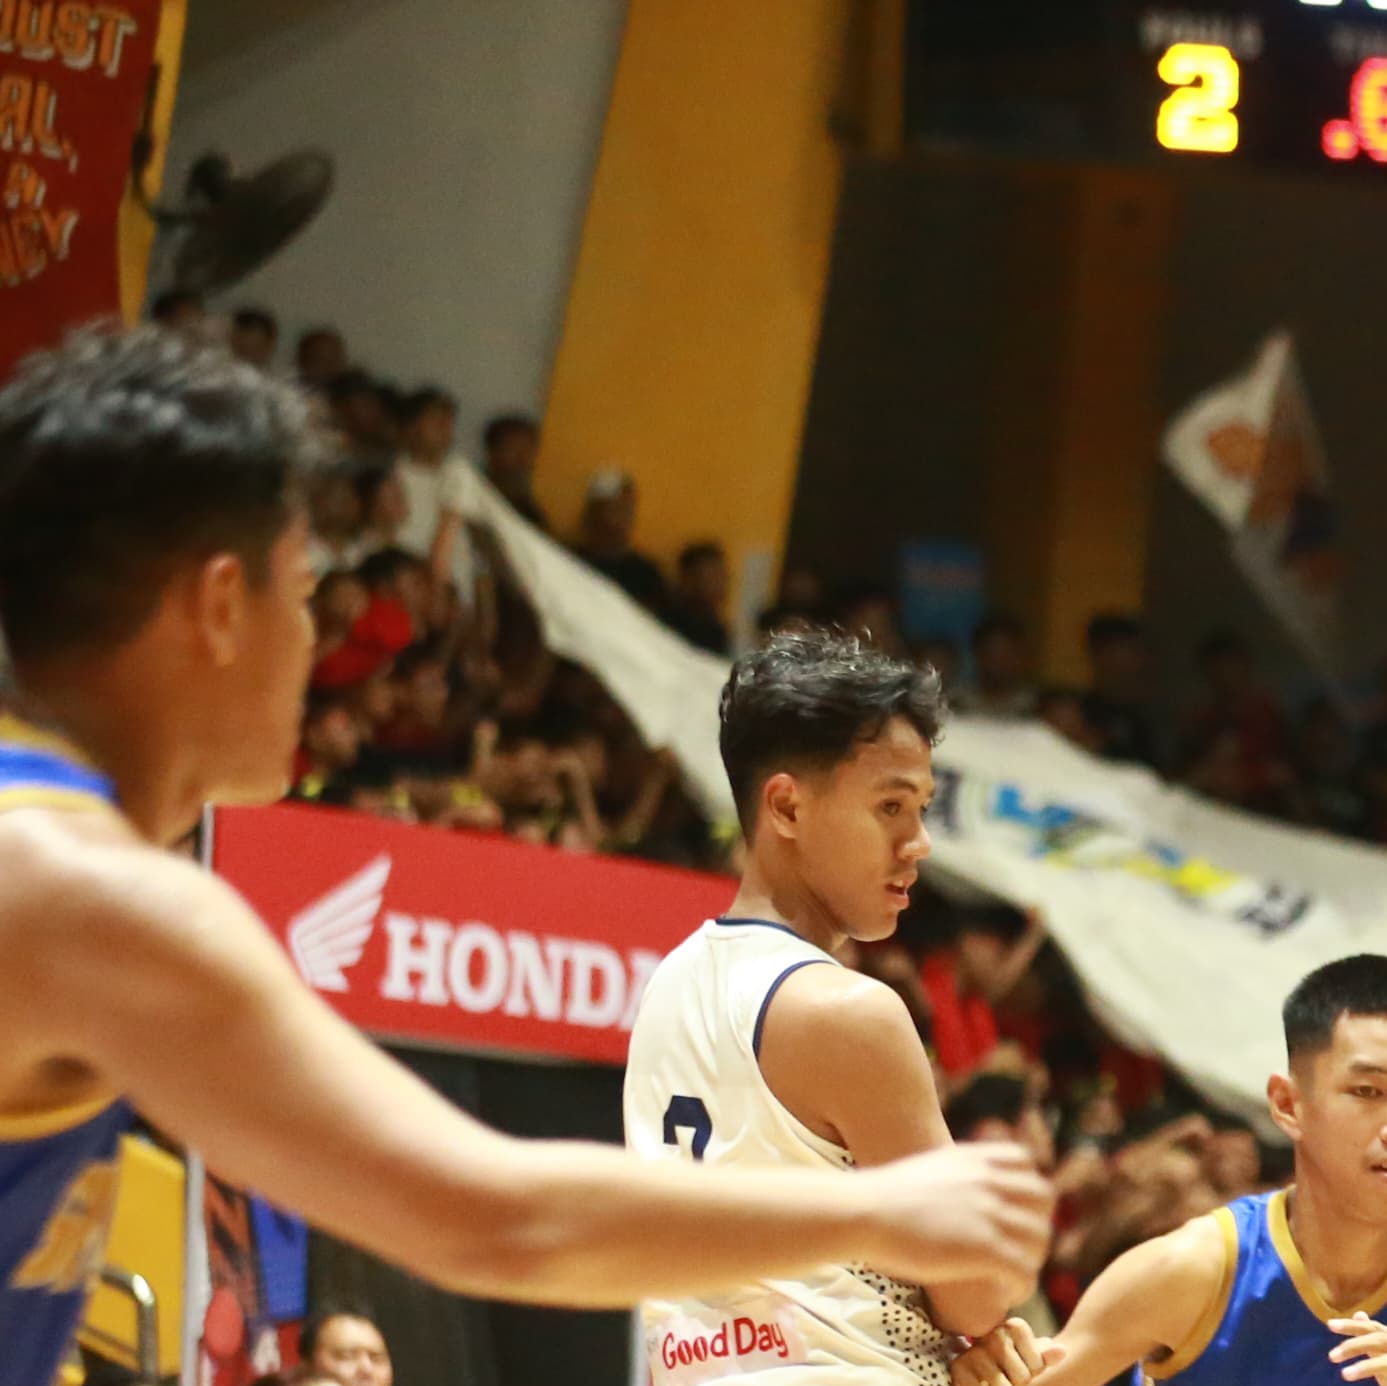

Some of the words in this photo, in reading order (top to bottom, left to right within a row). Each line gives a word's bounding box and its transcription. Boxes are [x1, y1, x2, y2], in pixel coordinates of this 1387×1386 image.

[1157, 43, 1239, 153] 2
[662, 1321, 730, 1370] Good
[733, 1316, 789, 1358] Day
